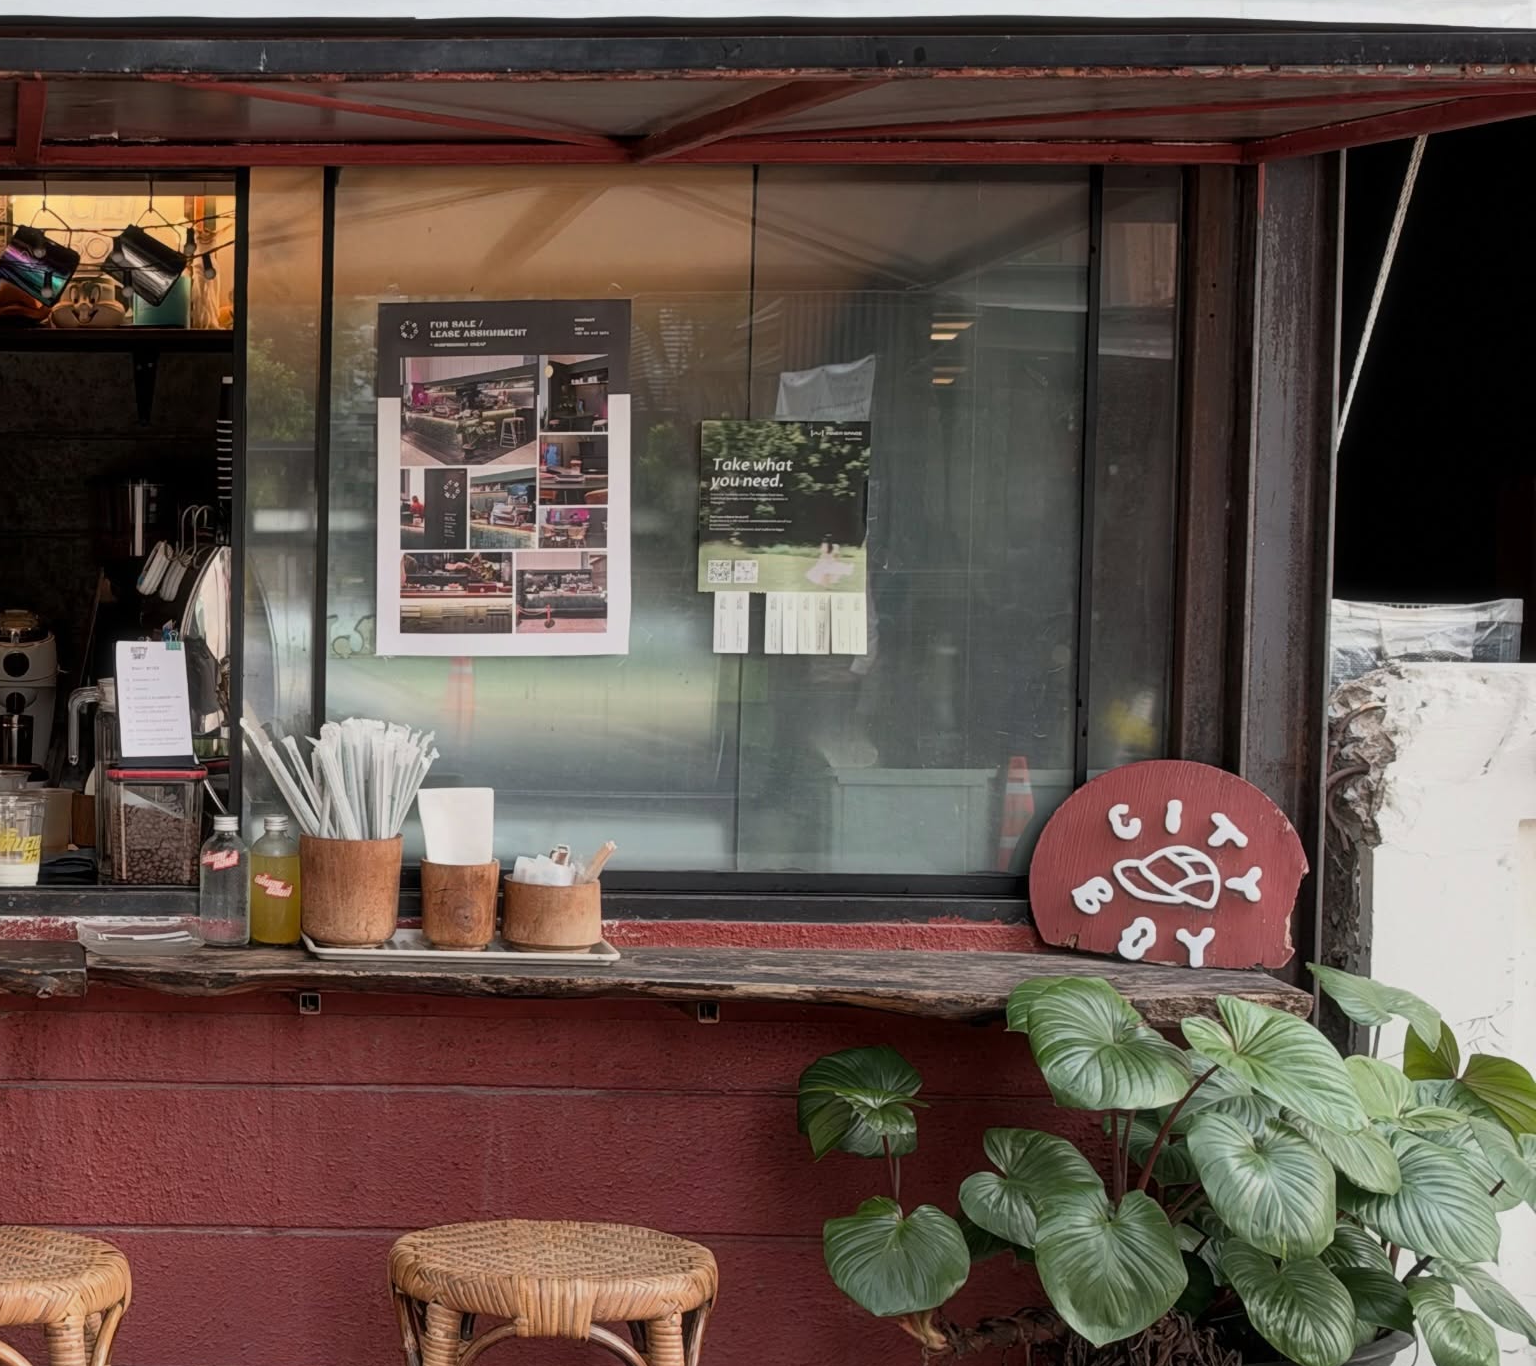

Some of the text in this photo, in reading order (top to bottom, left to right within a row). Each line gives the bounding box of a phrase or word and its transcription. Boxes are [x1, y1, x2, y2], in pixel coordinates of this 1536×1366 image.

[430, 321, 449, 329] FOR
[451, 320, 476, 329] SALE
[430, 328, 528, 338] LEASE ASSIGNMENT
[713, 456, 793, 471] Take what
[709, 474, 784, 491] you need.
[1108, 799, 1263, 902] CITY
[1071, 876, 1216, 968] BOY
